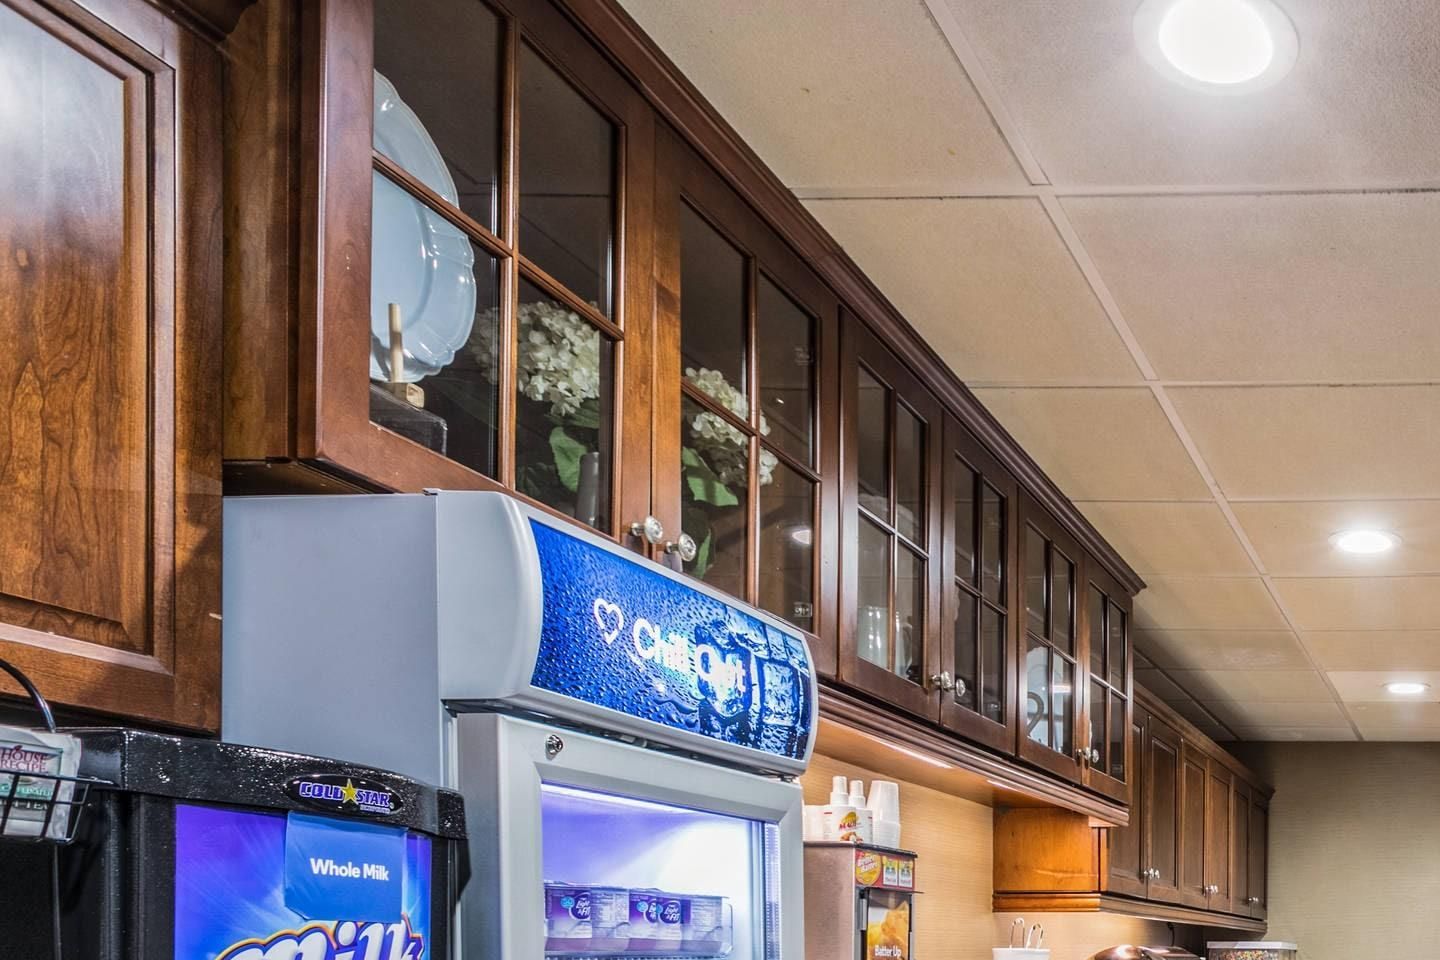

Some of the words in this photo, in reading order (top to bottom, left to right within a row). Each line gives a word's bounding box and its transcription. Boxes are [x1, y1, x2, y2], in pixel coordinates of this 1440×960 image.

[1, 748, 49, 763] HOUSE
[300, 782, 343, 801] COLD
[356, 789, 390, 807] STAR
[310, 857, 360, 880] Whole
[362, 862, 391, 882] Milk
